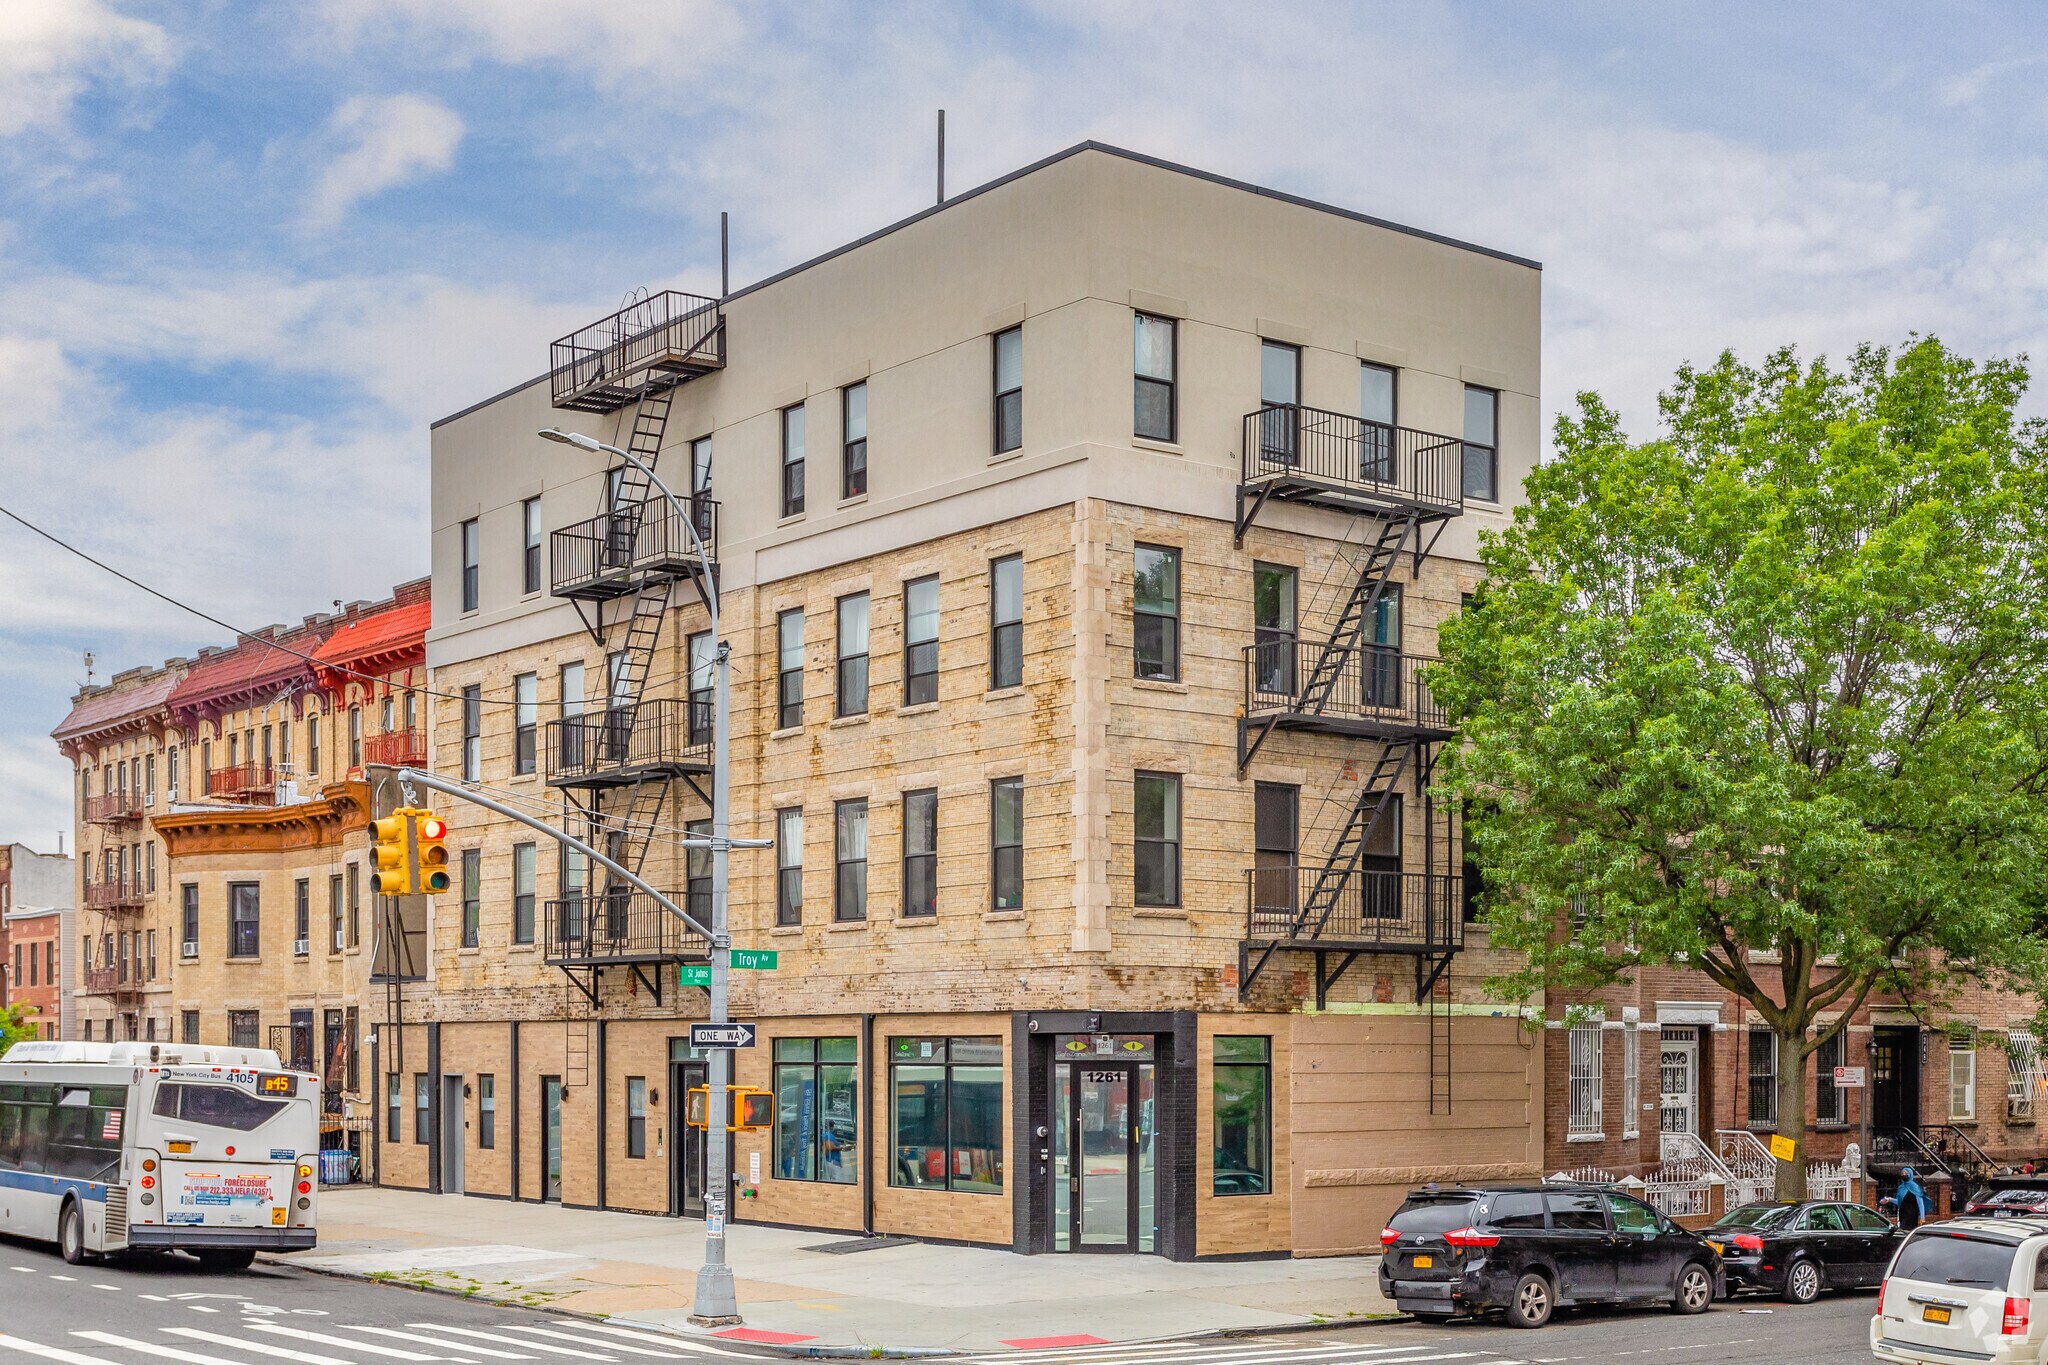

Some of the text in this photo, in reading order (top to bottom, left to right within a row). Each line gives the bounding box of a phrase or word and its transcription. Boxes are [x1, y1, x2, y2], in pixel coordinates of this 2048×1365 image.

[738, 952, 769, 969] Troy Av
[687, 968, 709, 979] St Johns
[700, 1031, 747, 1041] ONE WAY
[226, 1073, 254, 1084] 4105
[1087, 1071, 1121, 1083] 1261
[224, 1178, 267, 1188] FORECLOSURE
[209, 1186, 250, 1195] 212.333.HELP
[251, 1187, 272, 1196] (4357)
